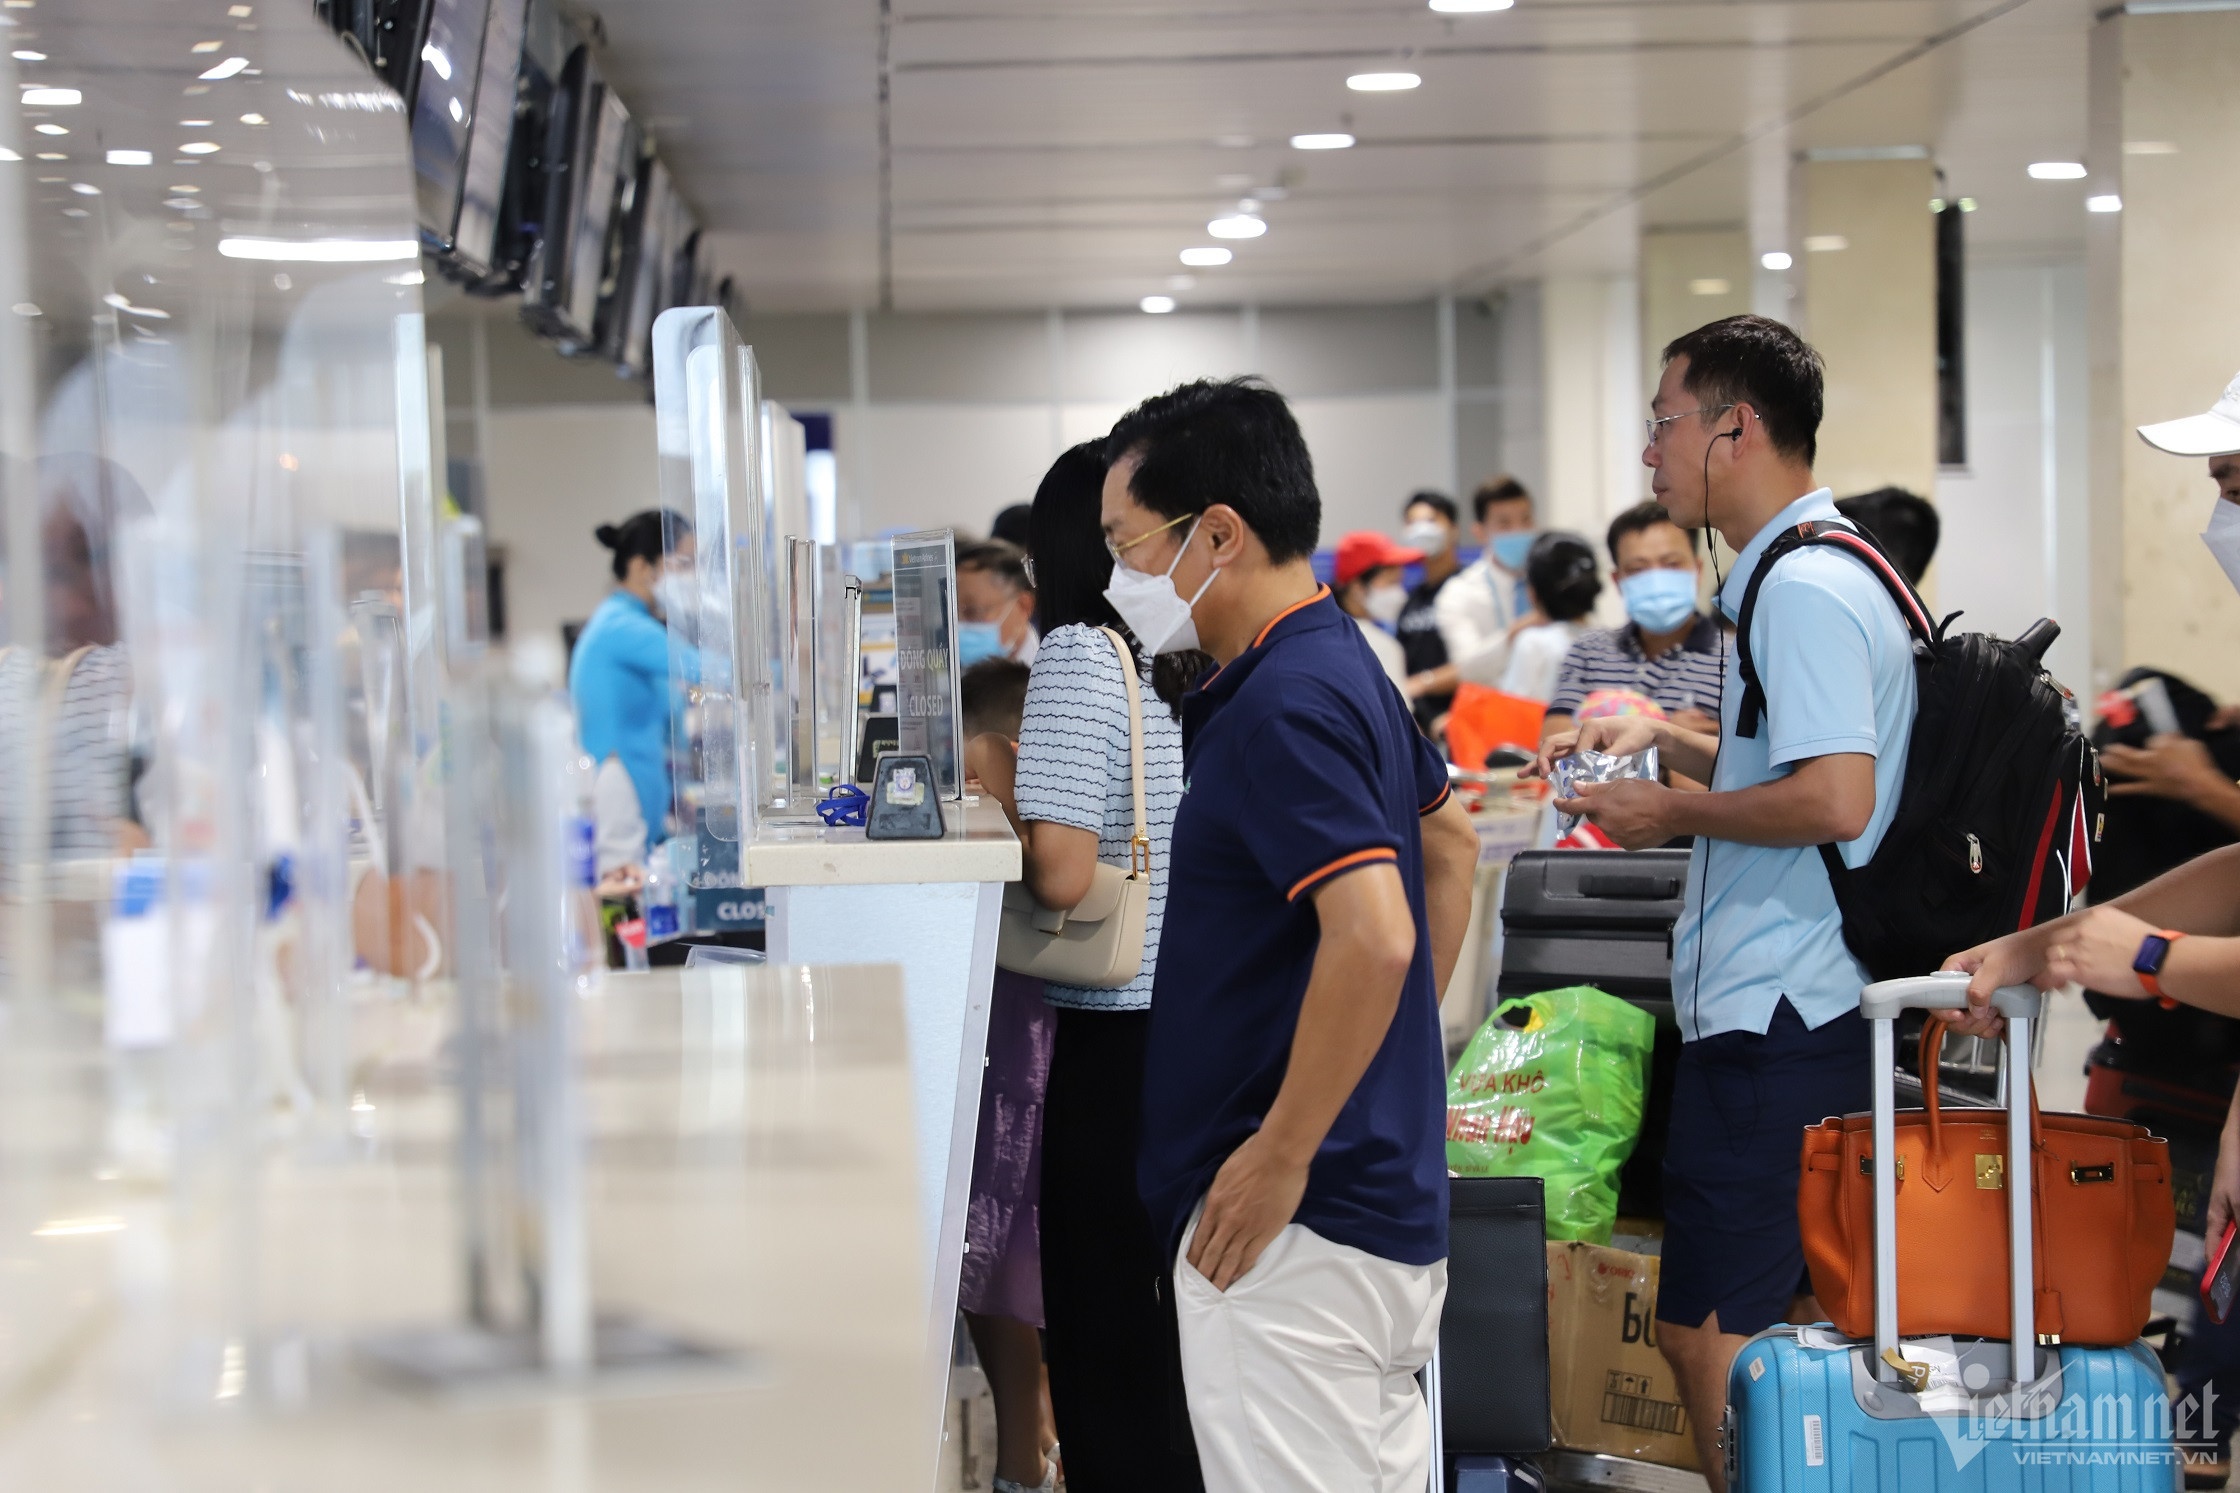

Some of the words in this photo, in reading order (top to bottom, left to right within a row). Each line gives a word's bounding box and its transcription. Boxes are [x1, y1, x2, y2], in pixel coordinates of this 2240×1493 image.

[900, 645, 926, 670] ĐÓNG
[909, 695, 943, 717] CLOSED
[1502, 1069, 1545, 1094] KHÔ
